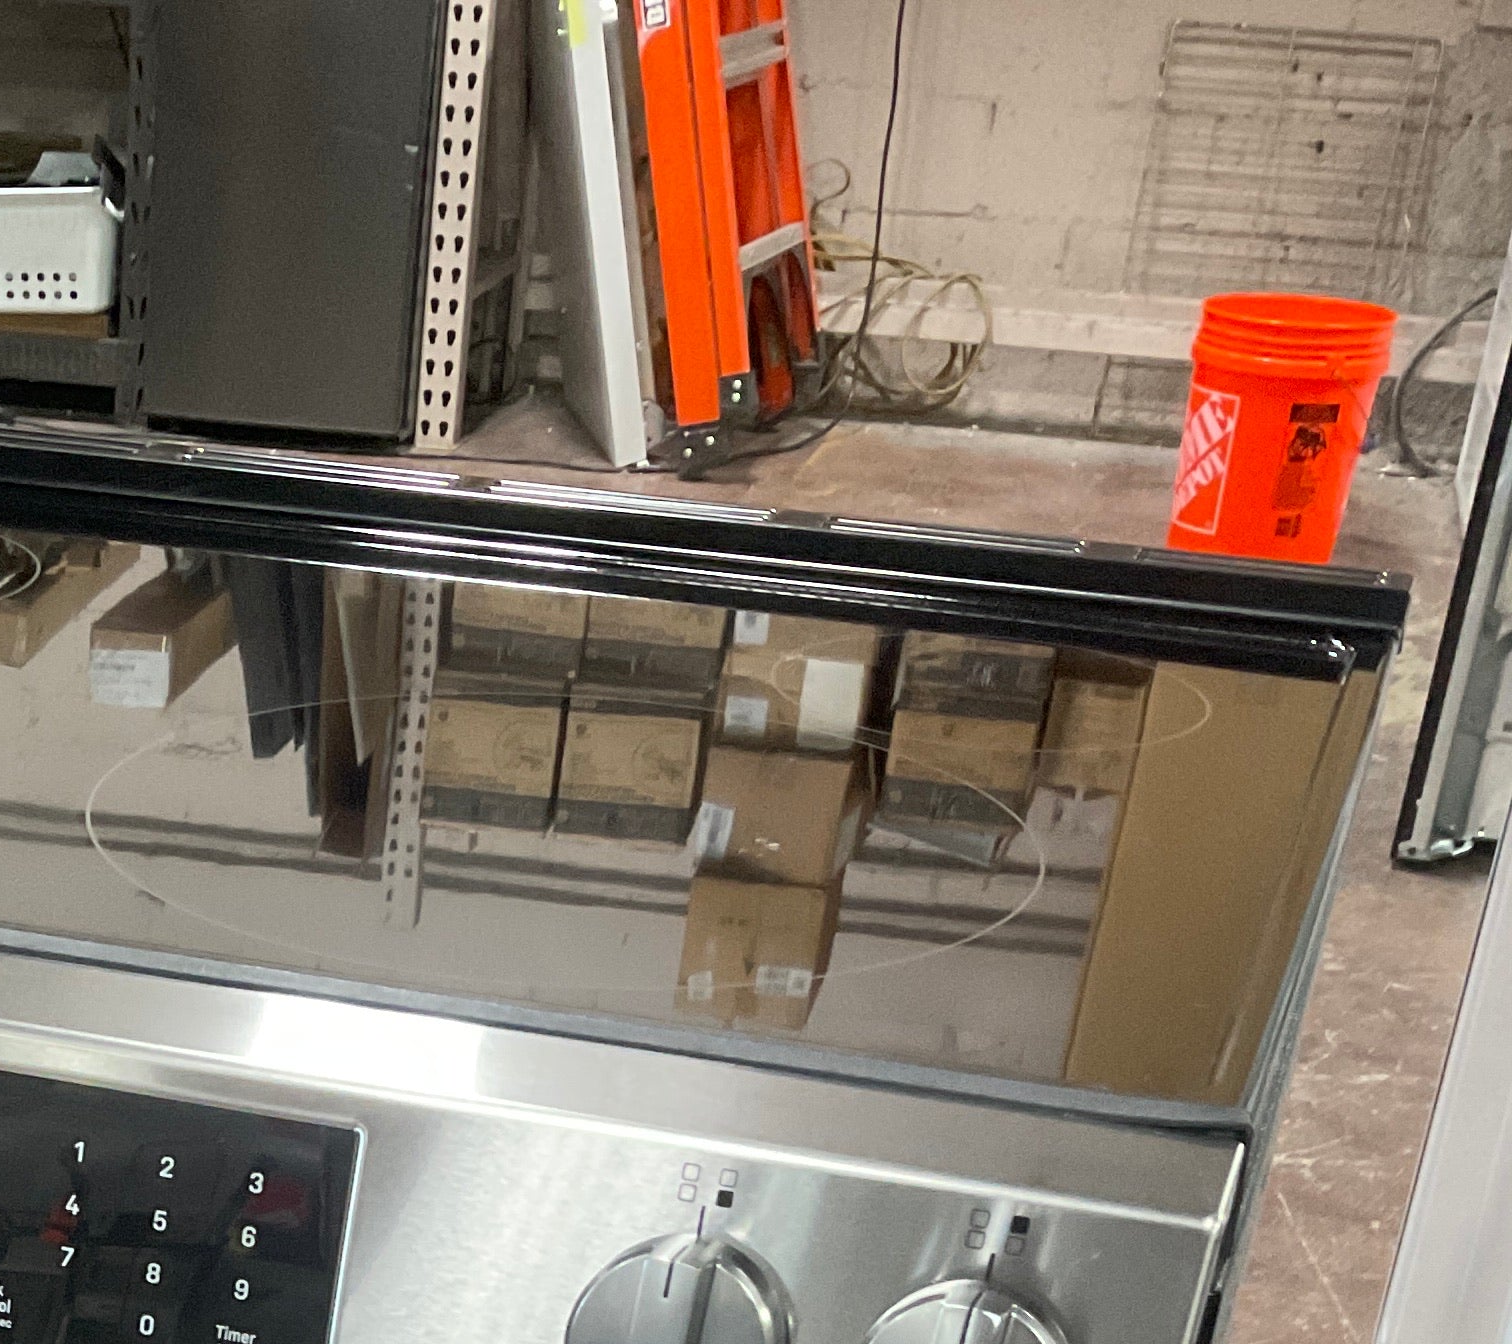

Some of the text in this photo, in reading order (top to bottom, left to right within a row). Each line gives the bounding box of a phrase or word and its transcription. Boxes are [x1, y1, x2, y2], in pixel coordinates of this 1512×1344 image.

[74, 1141, 85, 1162] 1
[159, 1156, 175, 1179] 2
[248, 1172, 264, 1194] 3
[65, 1194, 80, 1215] 4
[152, 1210, 168, 1231] 5
[241, 1226, 257, 1248] 6
[61, 1246, 75, 1267] 7
[145, 1263, 161, 1284] 8
[233, 1279, 250, 1300] 9
[139, 1314, 155, 1336] 0
[216, 1325, 257, 1344] Timer
